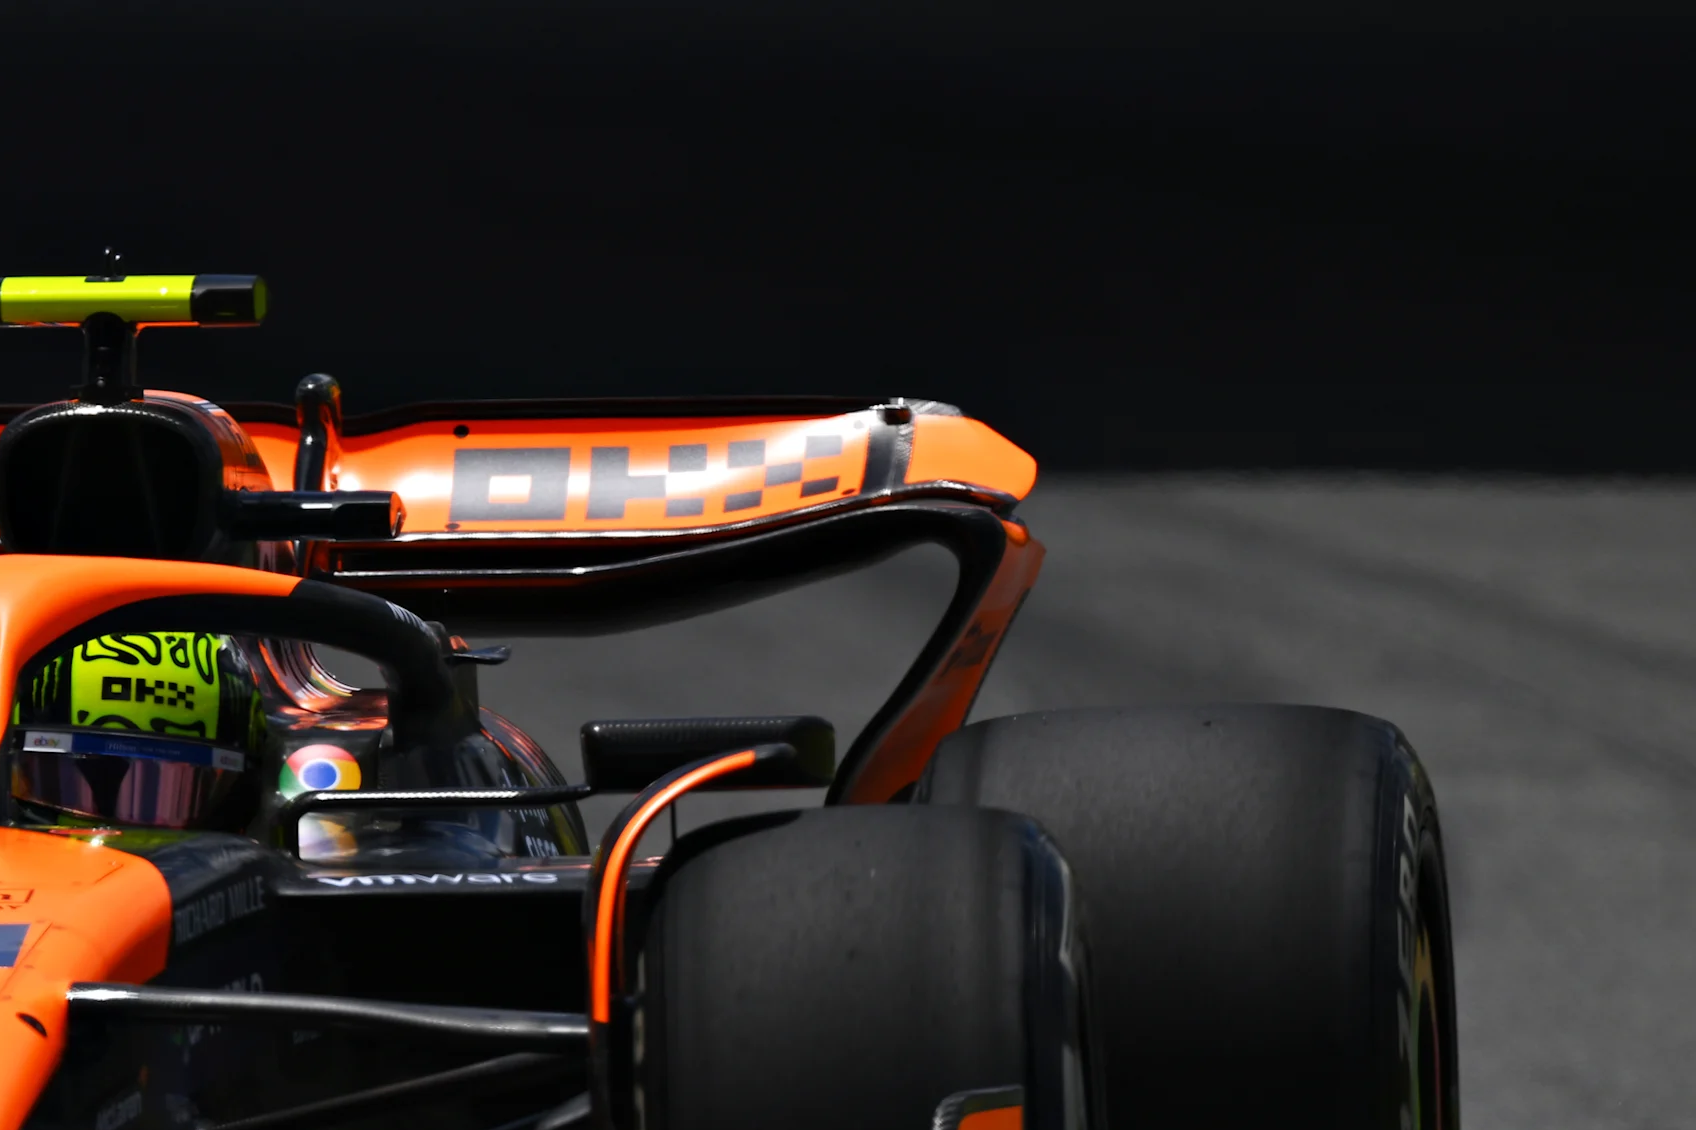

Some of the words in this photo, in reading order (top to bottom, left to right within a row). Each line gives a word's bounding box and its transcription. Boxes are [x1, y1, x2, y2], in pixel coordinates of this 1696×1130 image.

[448, 435, 843, 523] OKX
[101, 676, 195, 711] OKX
[228, 875, 266, 919] MILLE
[318, 873, 558, 887] vmware
